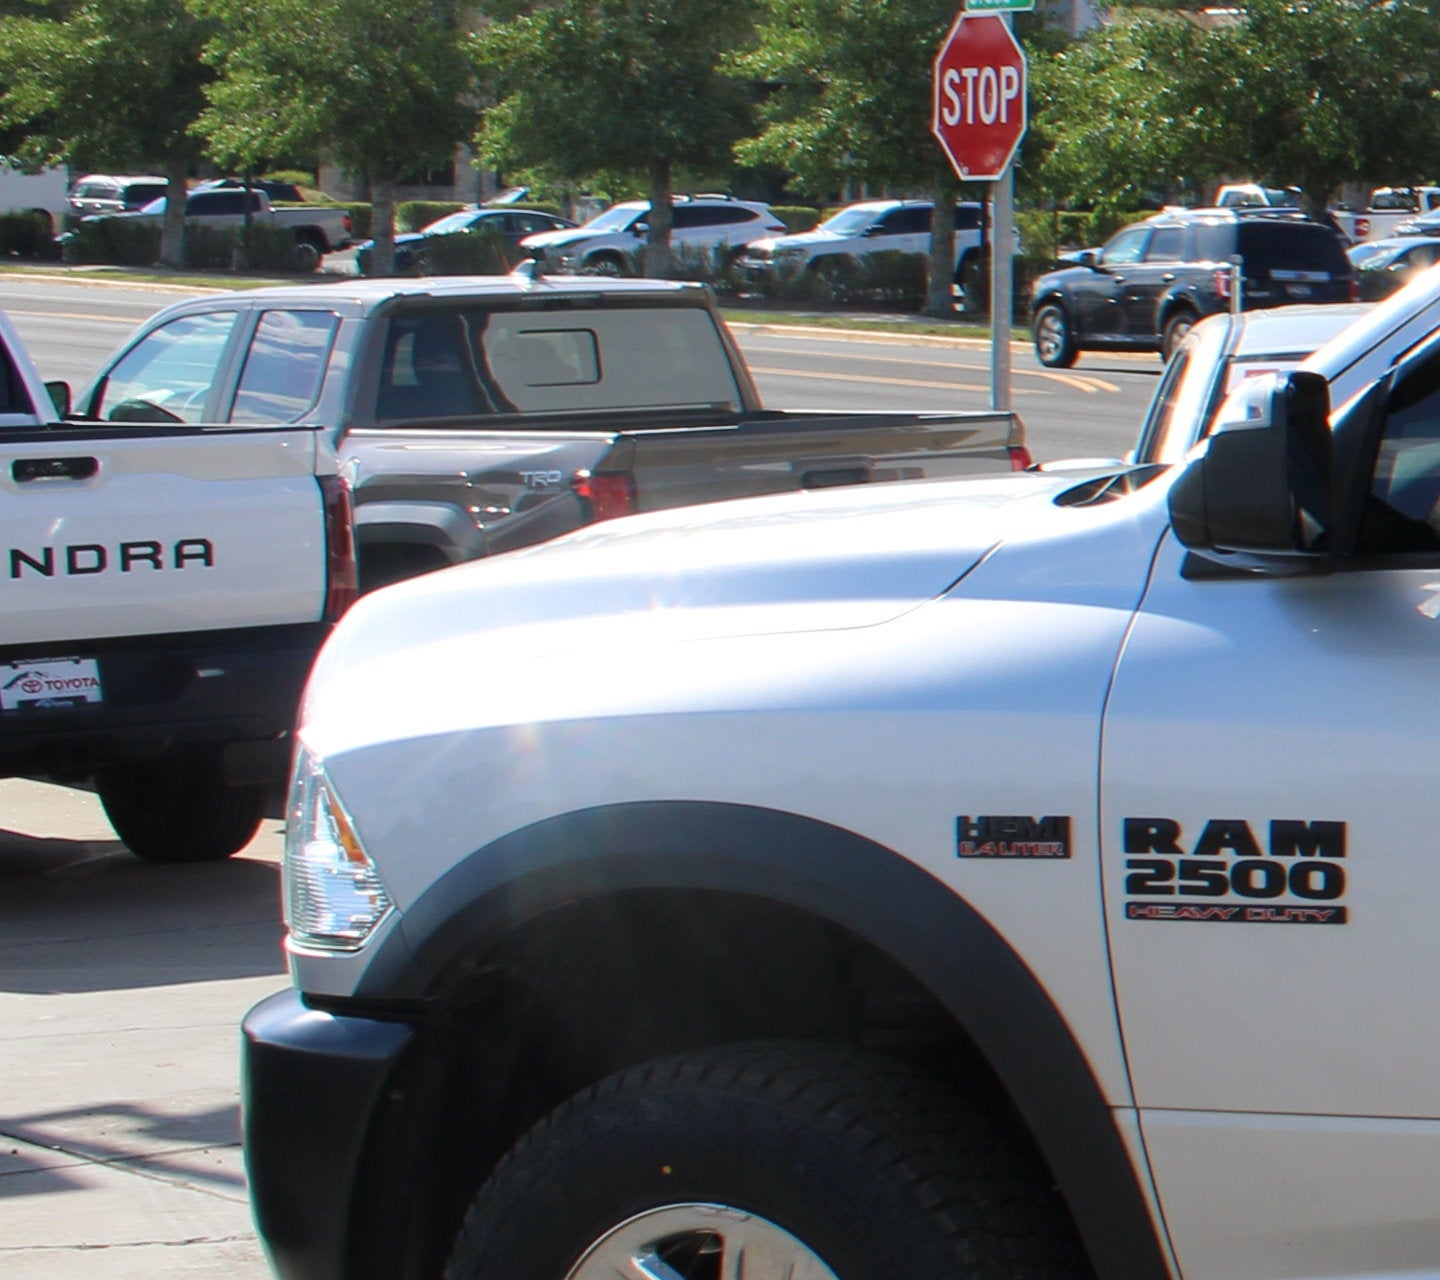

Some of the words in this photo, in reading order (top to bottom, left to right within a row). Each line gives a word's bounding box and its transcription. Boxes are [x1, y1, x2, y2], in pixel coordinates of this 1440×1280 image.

[942, 65, 1019, 126] STOP
[519, 470, 562, 487] TRD
[10, 538, 213, 578] NDRA
[45, 677, 99, 690] TOYOTA
[957, 816, 1070, 840] HEMI
[1124, 818, 1347, 858] RAM
[998, 841, 1064, 856] LITER
[1126, 859, 1346, 900] 2500
[1129, 904, 1240, 921] HEAVY
[1244, 907, 1337, 922] DUTY
